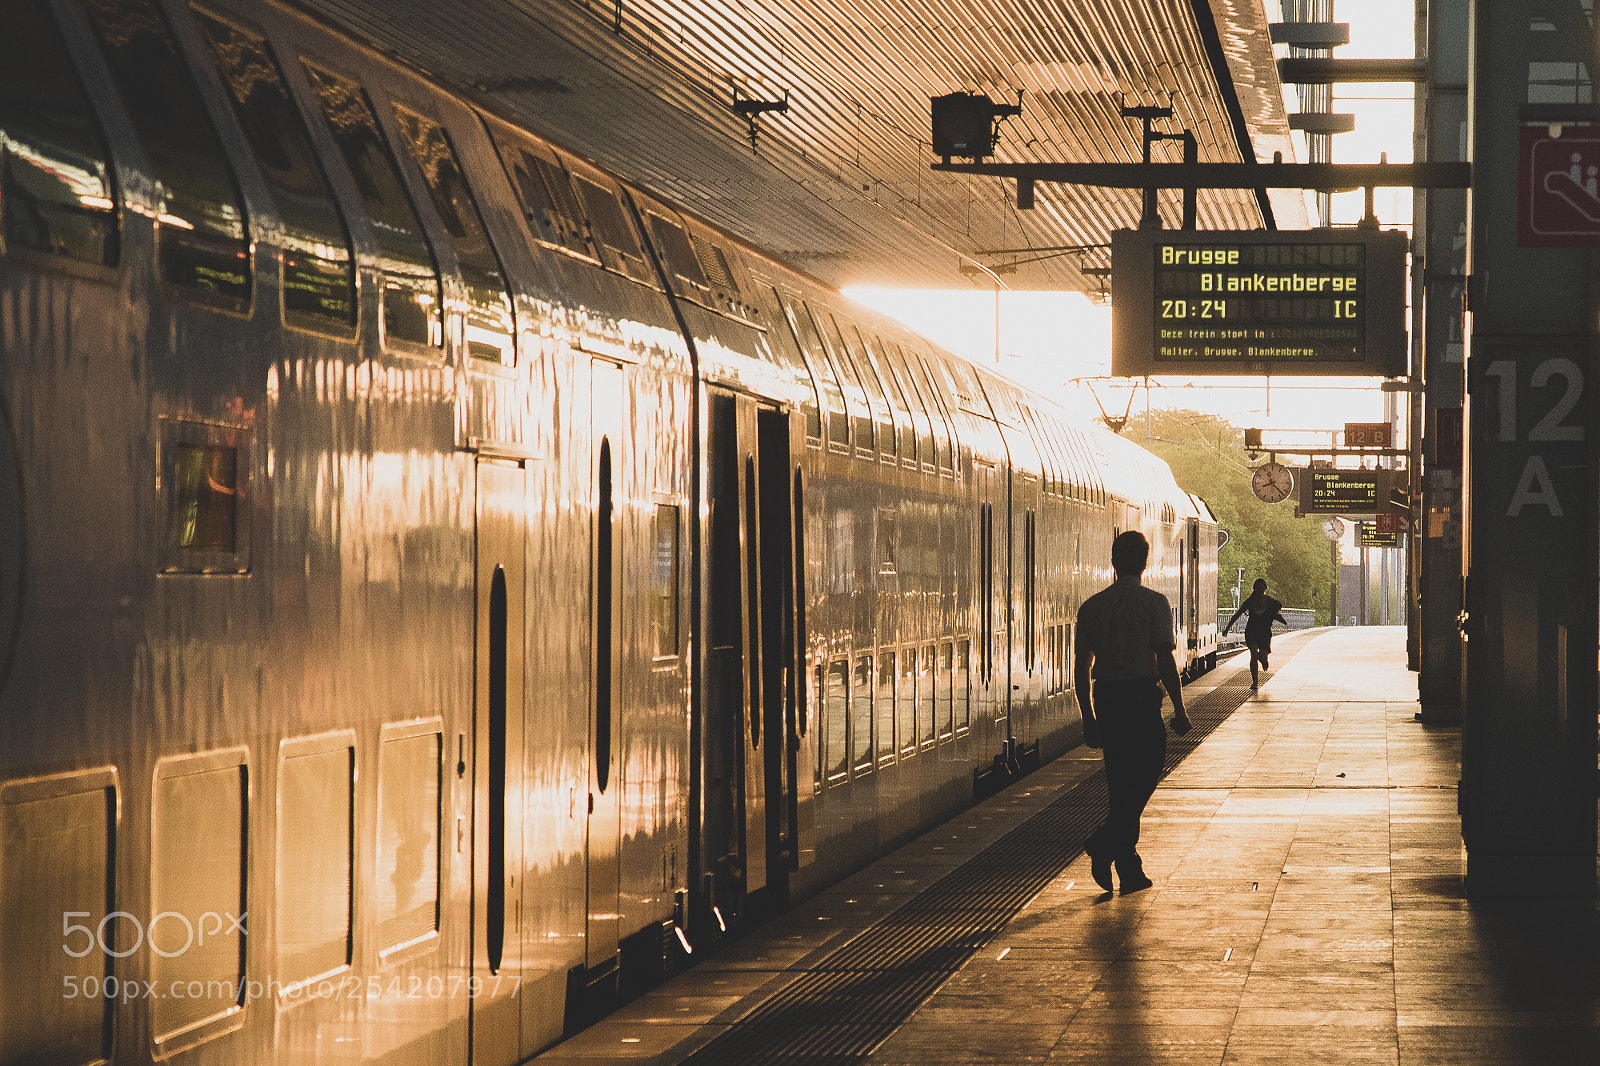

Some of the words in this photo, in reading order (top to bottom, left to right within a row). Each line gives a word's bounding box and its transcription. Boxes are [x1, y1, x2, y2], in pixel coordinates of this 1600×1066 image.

[1161, 246, 1240, 265] Brugge
[1200, 273, 1357, 292] Blankenberge
[1161, 300, 1226, 319] 20:24
[1334, 300, 1357, 319] IC
[1161, 329, 1183, 339] Deze
[1189, 329, 1216, 339] trein
[1221, 329, 1248, 339] stopt
[1254, 329, 1265, 339] in
[1485, 357, 1585, 442] 12
[1374, 431, 1384, 443] B
[1314, 489, 1336, 497] 20:24
[1505, 455, 1564, 517] A
